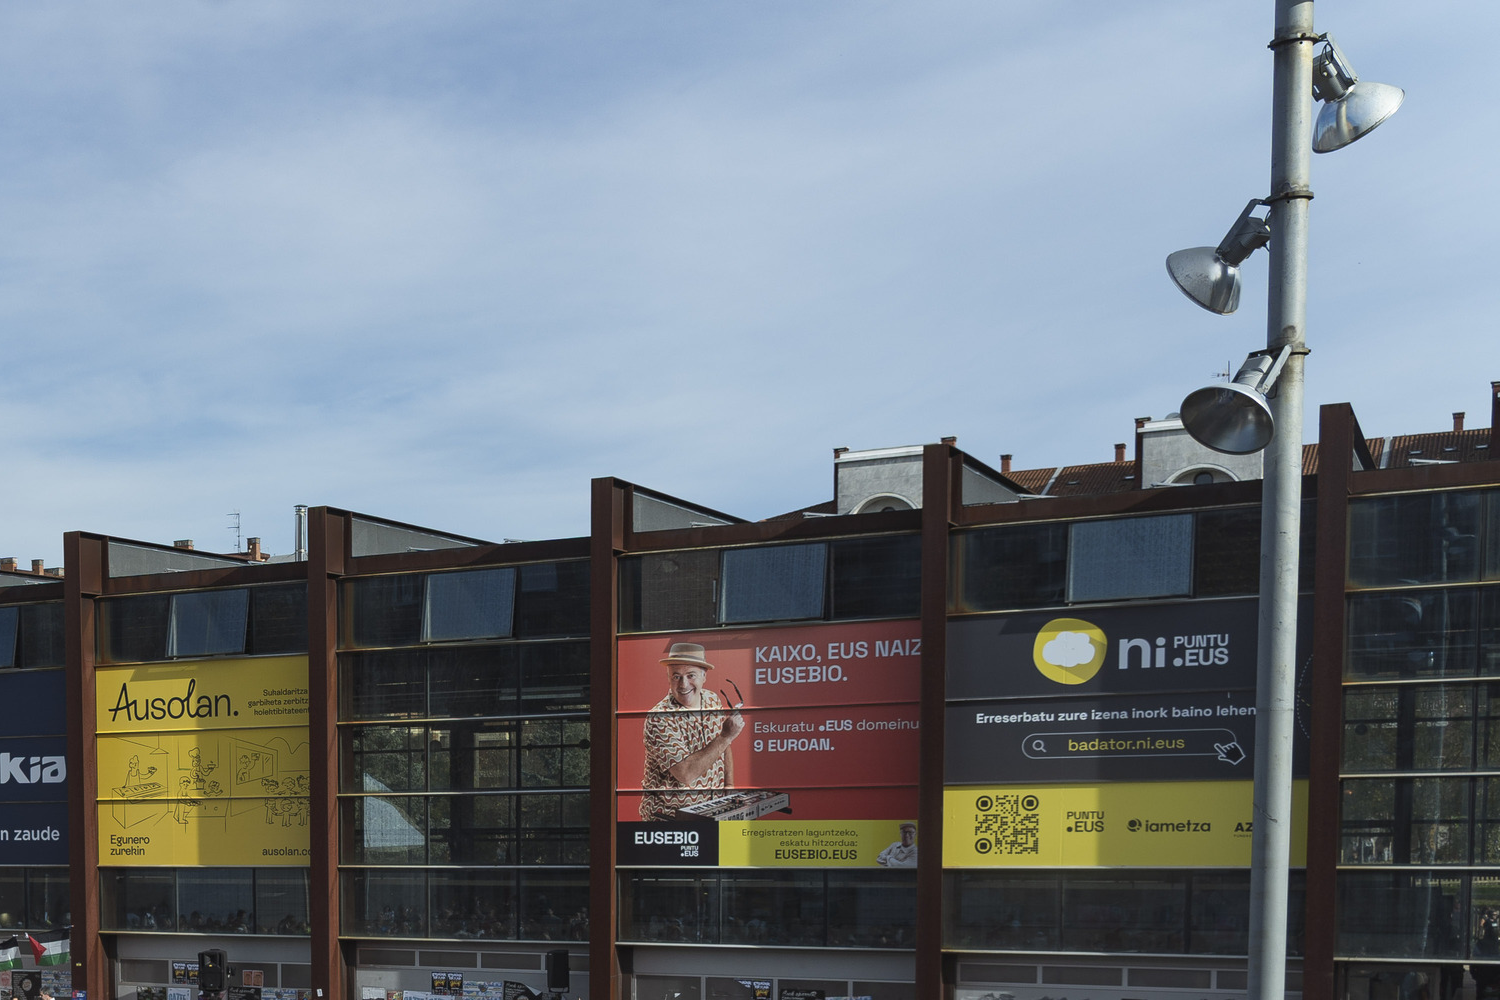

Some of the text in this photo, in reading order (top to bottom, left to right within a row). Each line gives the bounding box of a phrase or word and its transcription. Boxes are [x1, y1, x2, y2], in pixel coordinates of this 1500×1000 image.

[1173, 633, 1229, 649] PUNTU
[755, 639, 921, 663] KAIXO, EUS NAIZ
[1118, 637, 1166, 669] ni
[1173, 648, 1229, 667] .EUS
[755, 665, 848, 685] EUSEBIO.
[263, 688, 308, 697] Sukaldaritza
[108, 678, 239, 722] Ausolan.
[976, 711, 1055, 724] Erreserbatu
[1057, 711, 1088, 721] zure
[1091, 708, 1128, 720] izena
[1131, 707, 1168, 719] inork
[1172, 706, 1212, 718] baino
[754, 721, 814, 733] Eskuratu
[818, 719, 853, 732] .EUS
[754, 738, 835, 752] 9 EUROAN.
[1068, 737, 1185, 752] badator.ni.eus
[1066, 811, 1104, 820] PUNTU
[13, 826, 60, 841] zaude
[741, 828, 858, 838] Erregistratzen laguntzeko,
[1066, 820, 1104, 833] .EUS
[1145, 820, 1211, 833] iametza
[110, 835, 150, 846] Egunero
[635, 831, 699, 845] EUSEBIO
[779, 839, 858, 847] eskatu hitzordua:
[110, 846, 145, 856] zurekin
[774, 849, 858, 860] EUSEBIO.EUS
